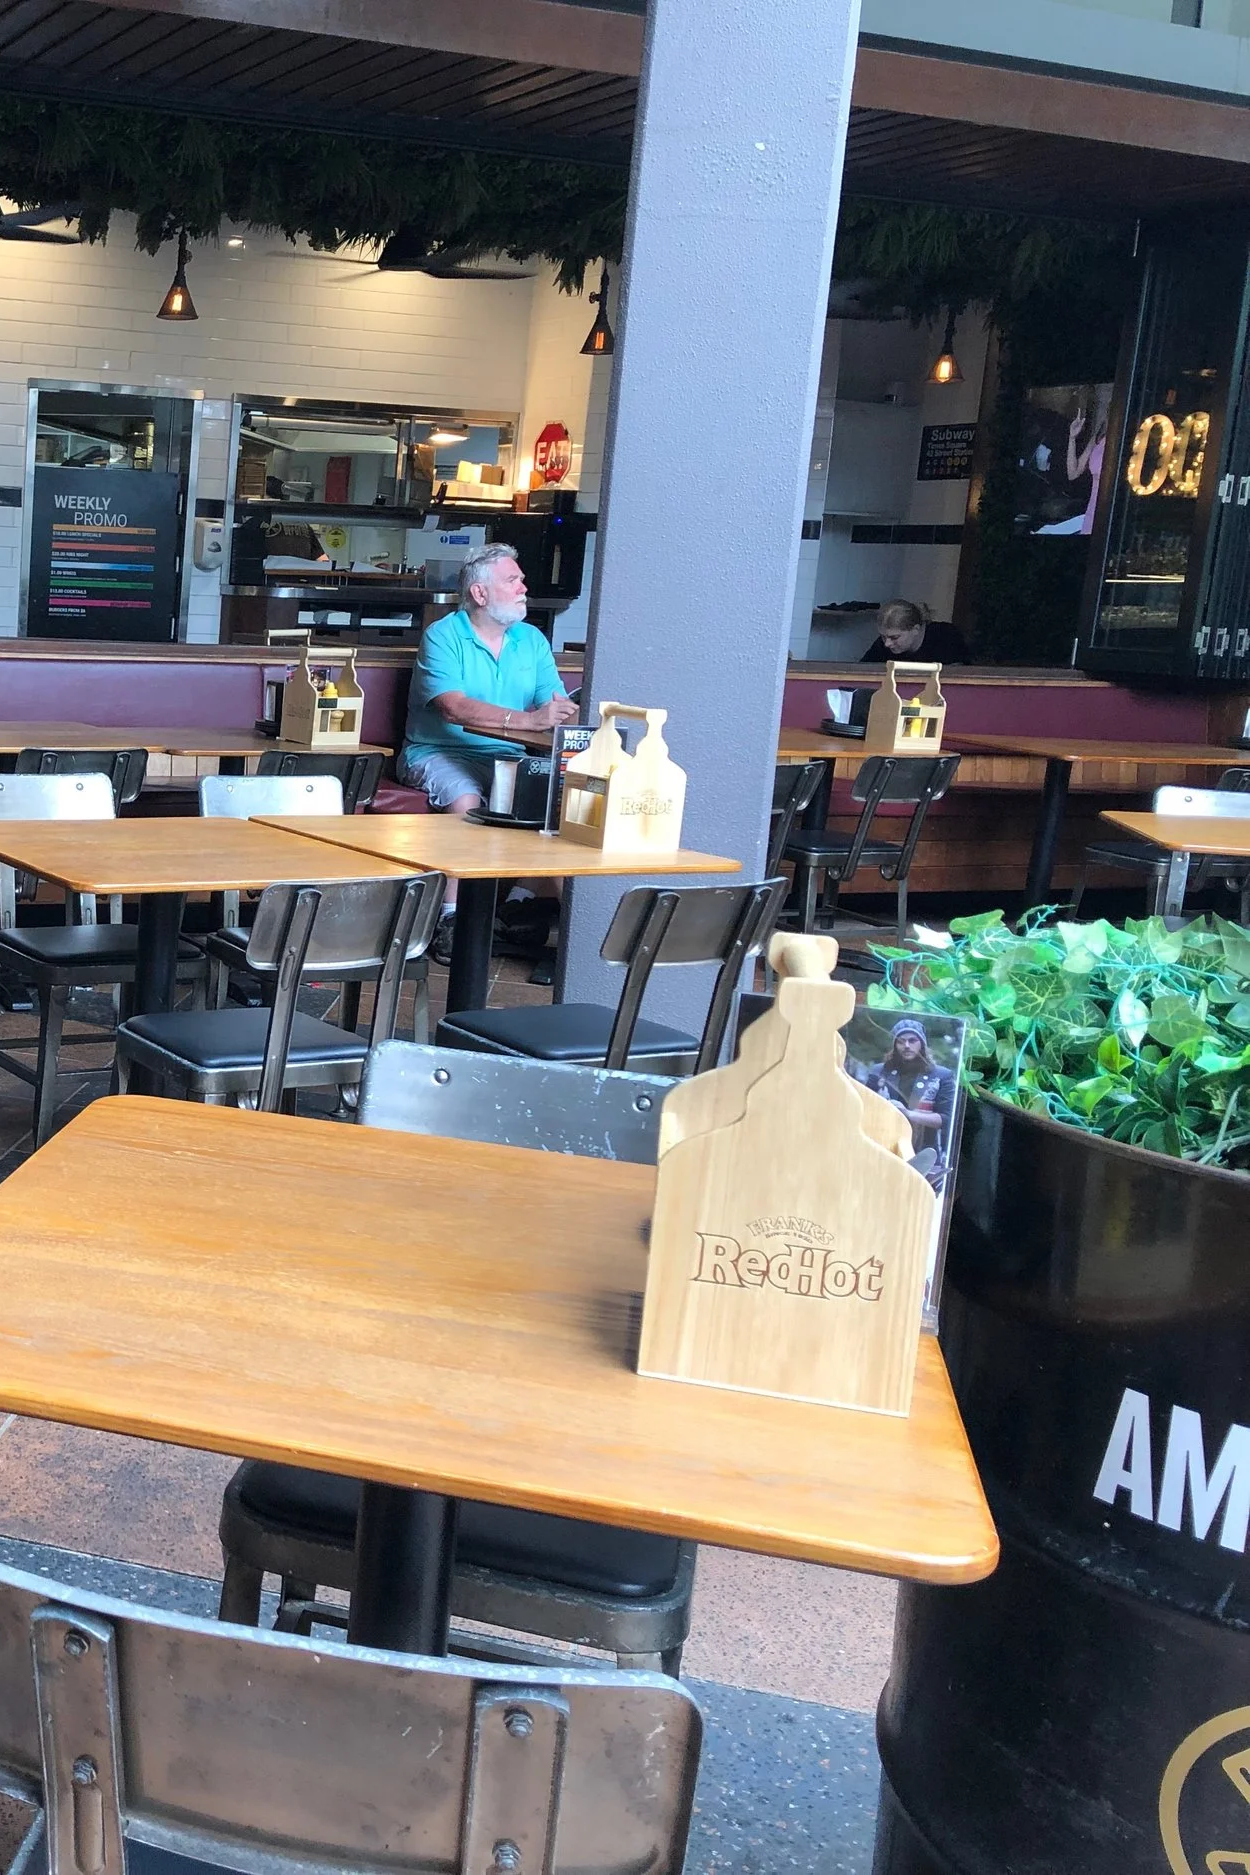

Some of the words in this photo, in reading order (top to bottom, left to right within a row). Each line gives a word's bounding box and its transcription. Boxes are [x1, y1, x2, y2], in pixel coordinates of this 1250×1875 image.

[930, 429, 975, 441] Subway
[536, 440, 569, 471] EAT
[54, 494, 112, 511] WEEKLY
[74, 511, 128, 528] PROMO
[564, 729, 595, 740] WEEK
[745, 1215, 835, 1246] FRANK'S
[689, 1231, 885, 1302] RedHot
